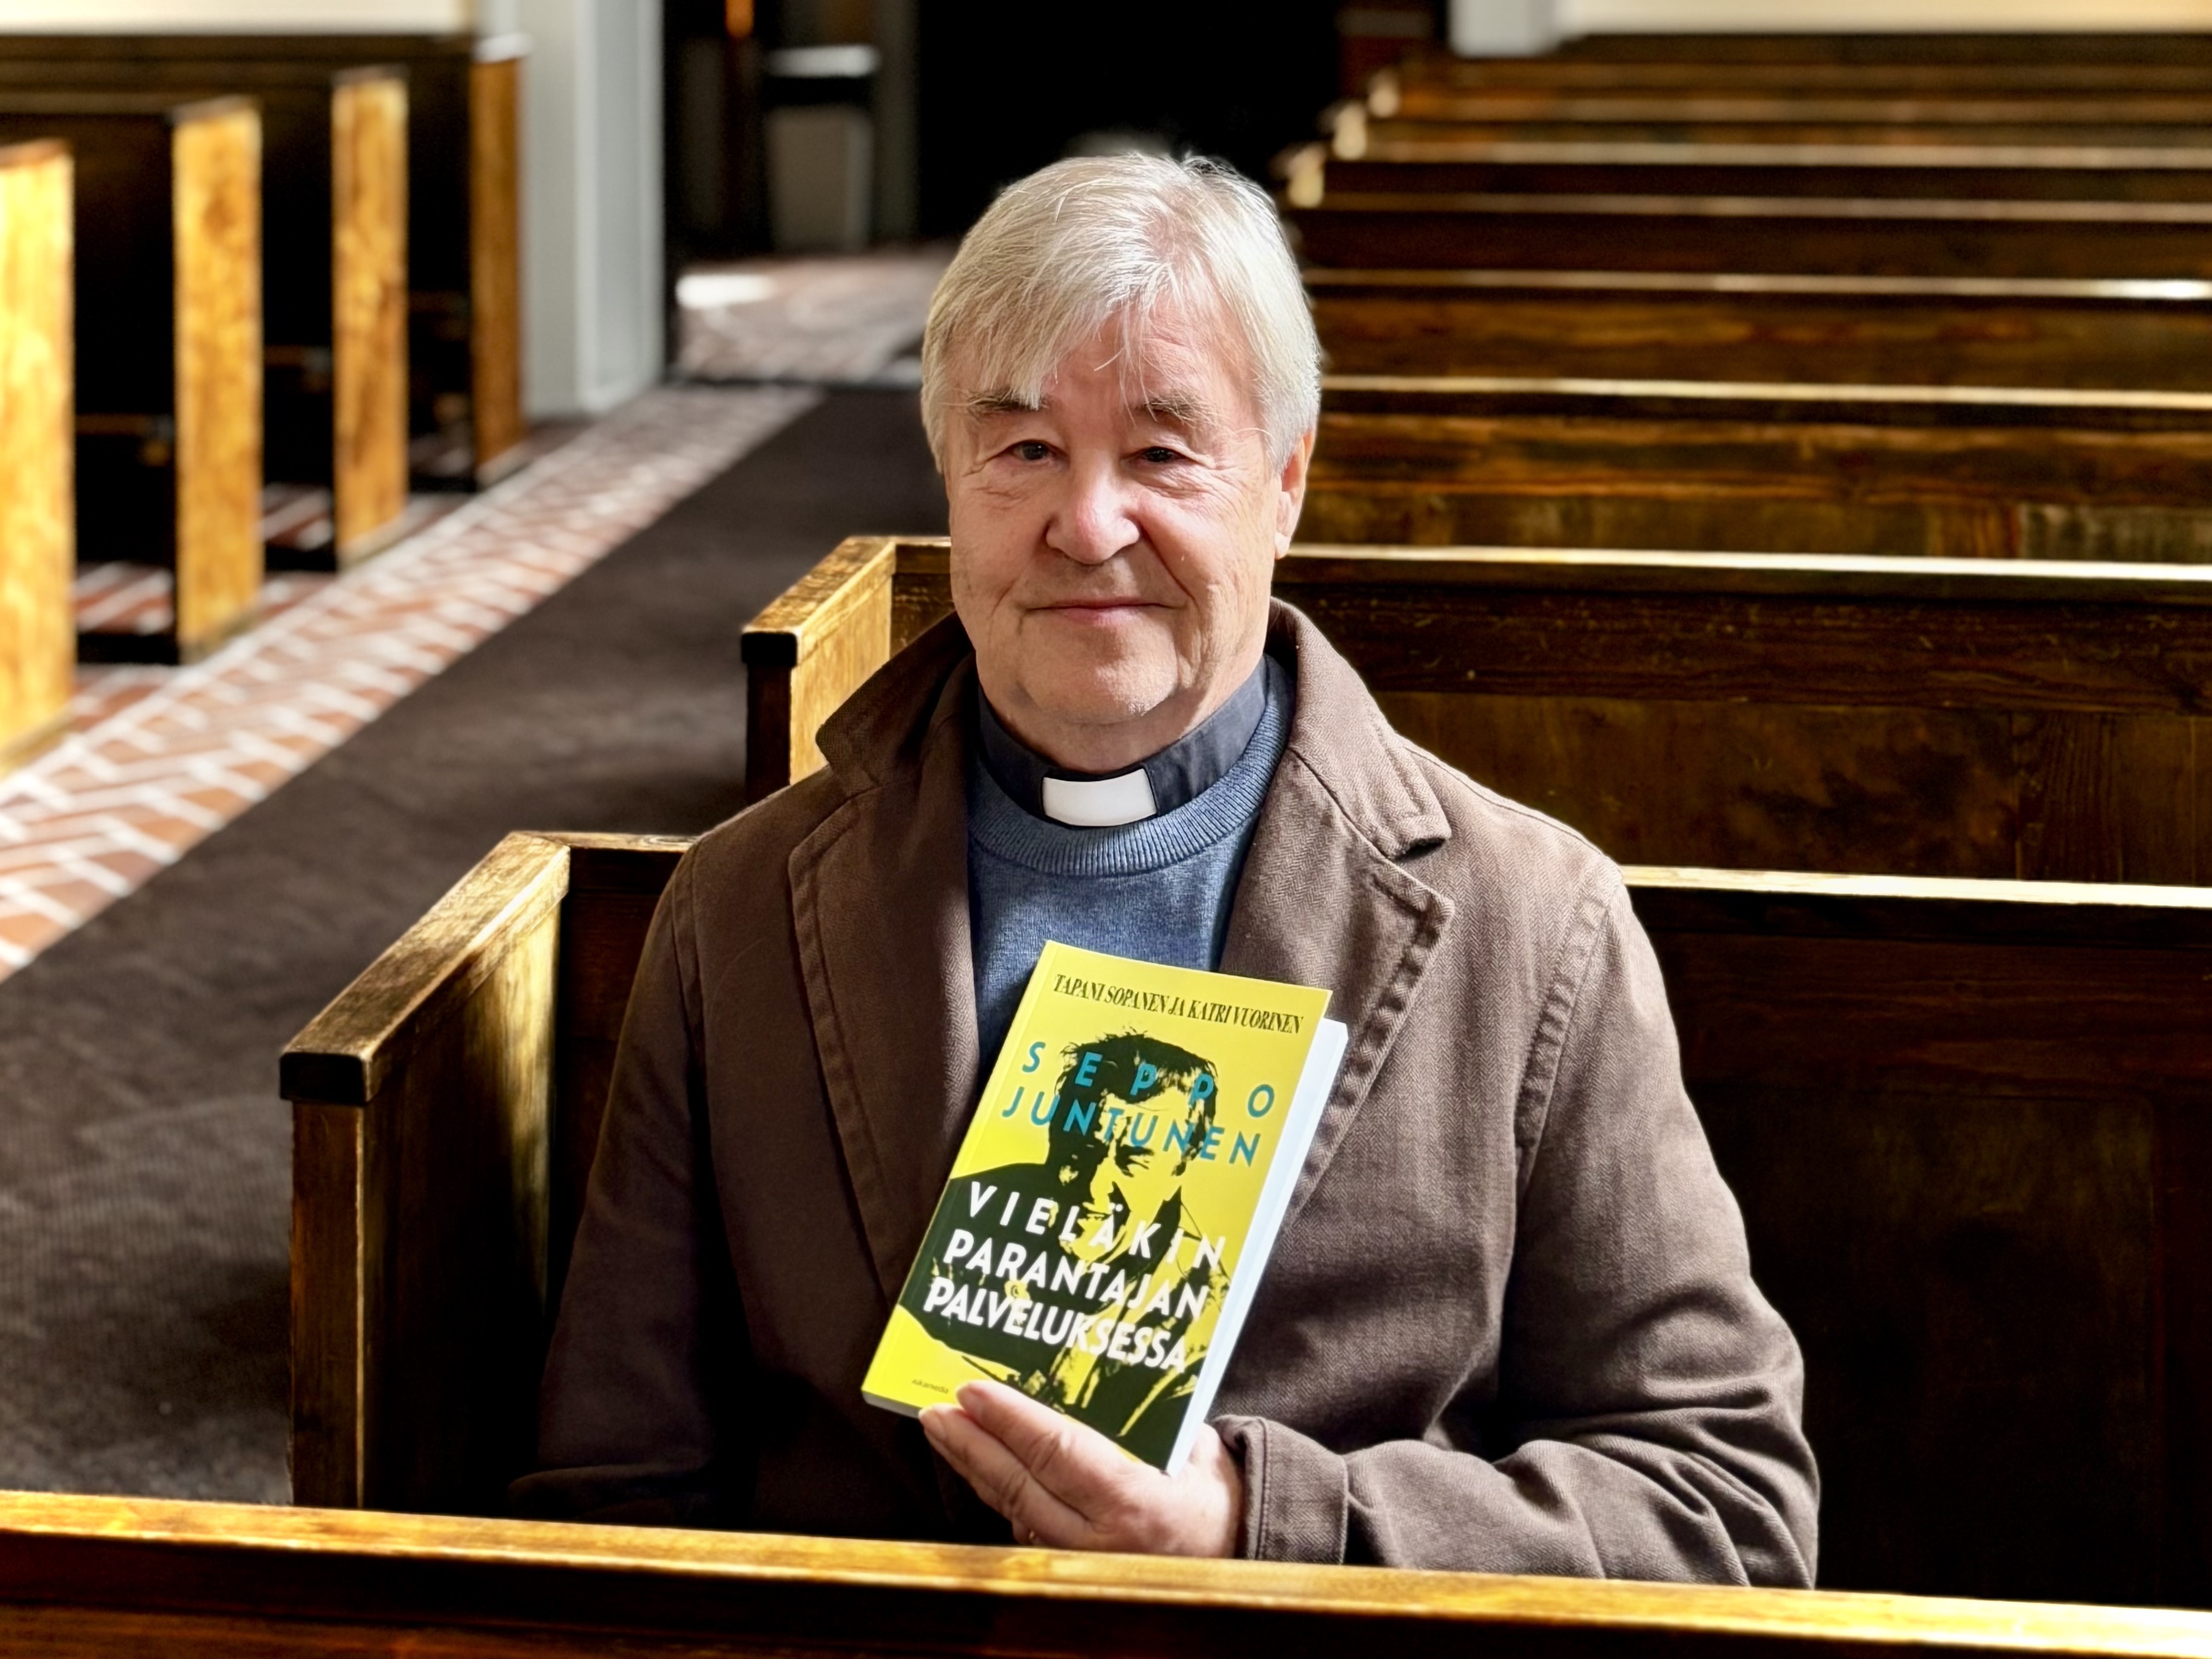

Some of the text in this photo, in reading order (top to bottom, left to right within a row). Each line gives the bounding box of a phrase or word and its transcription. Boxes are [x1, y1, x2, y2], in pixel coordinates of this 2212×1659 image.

[1054, 973, 1304, 1035] TAPANI SOPANEN JA KATRI VUORINEN
[1022, 1041, 1275, 1118] SEPPO
[1001, 1086, 1261, 1167] JUNTUNEN
[969, 1181, 1226, 1270] VIELÄKIN
[943, 1228, 1208, 1321] PARANTAJAN
[923, 1277, 1186, 1373] PALVELUKSESSA
